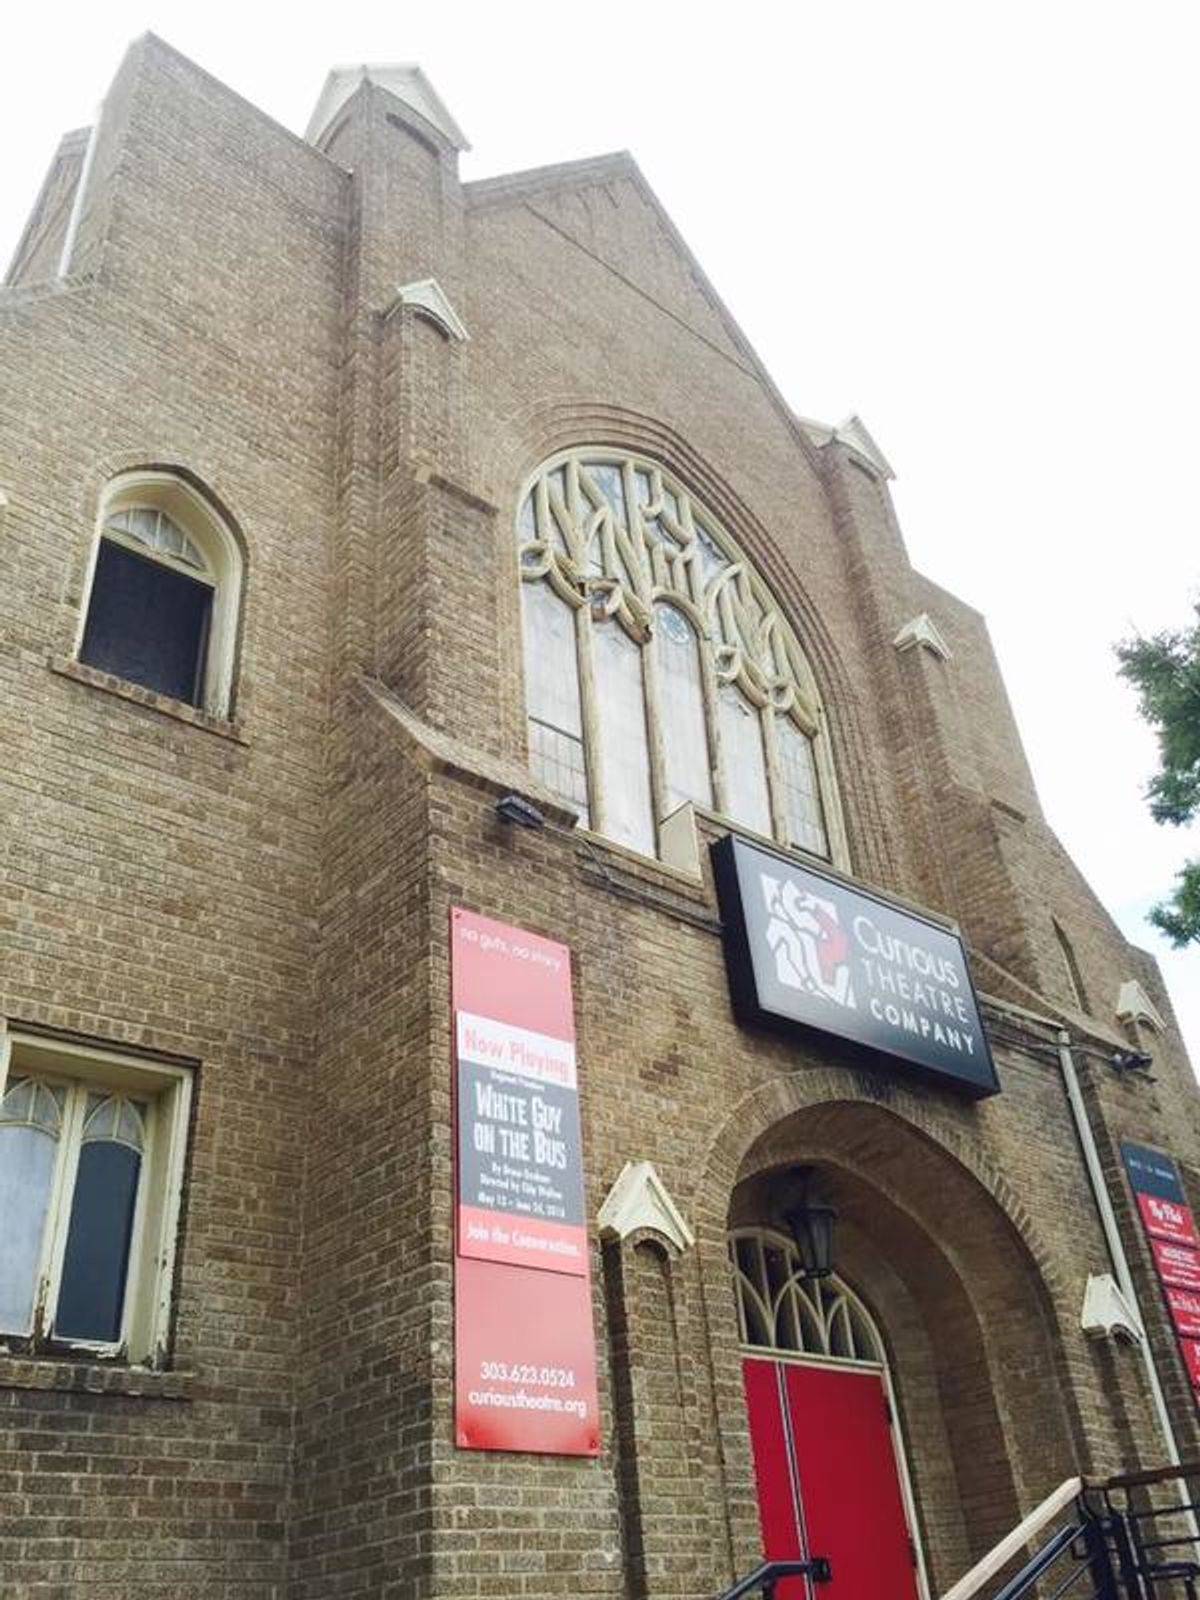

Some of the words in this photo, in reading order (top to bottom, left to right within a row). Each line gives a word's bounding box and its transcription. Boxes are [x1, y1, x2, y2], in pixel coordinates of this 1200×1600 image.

[861, 957, 969, 1024] THEATRE
[870, 999, 974, 1055] COMPANY
[464, 1028, 504, 1058] Now
[508, 1040, 570, 1085] Playing
[475, 1082, 527, 1126] WHITE
[531, 1096, 562, 1134] GUY
[474, 1122, 496, 1154] ON
[499, 1129, 530, 1161] THE
[534, 1131, 567, 1170] BUS
[466, 1222, 489, 1241] Join
[491, 1226, 510, 1242] the
[480, 1361, 575, 1388] 303.623.0524
